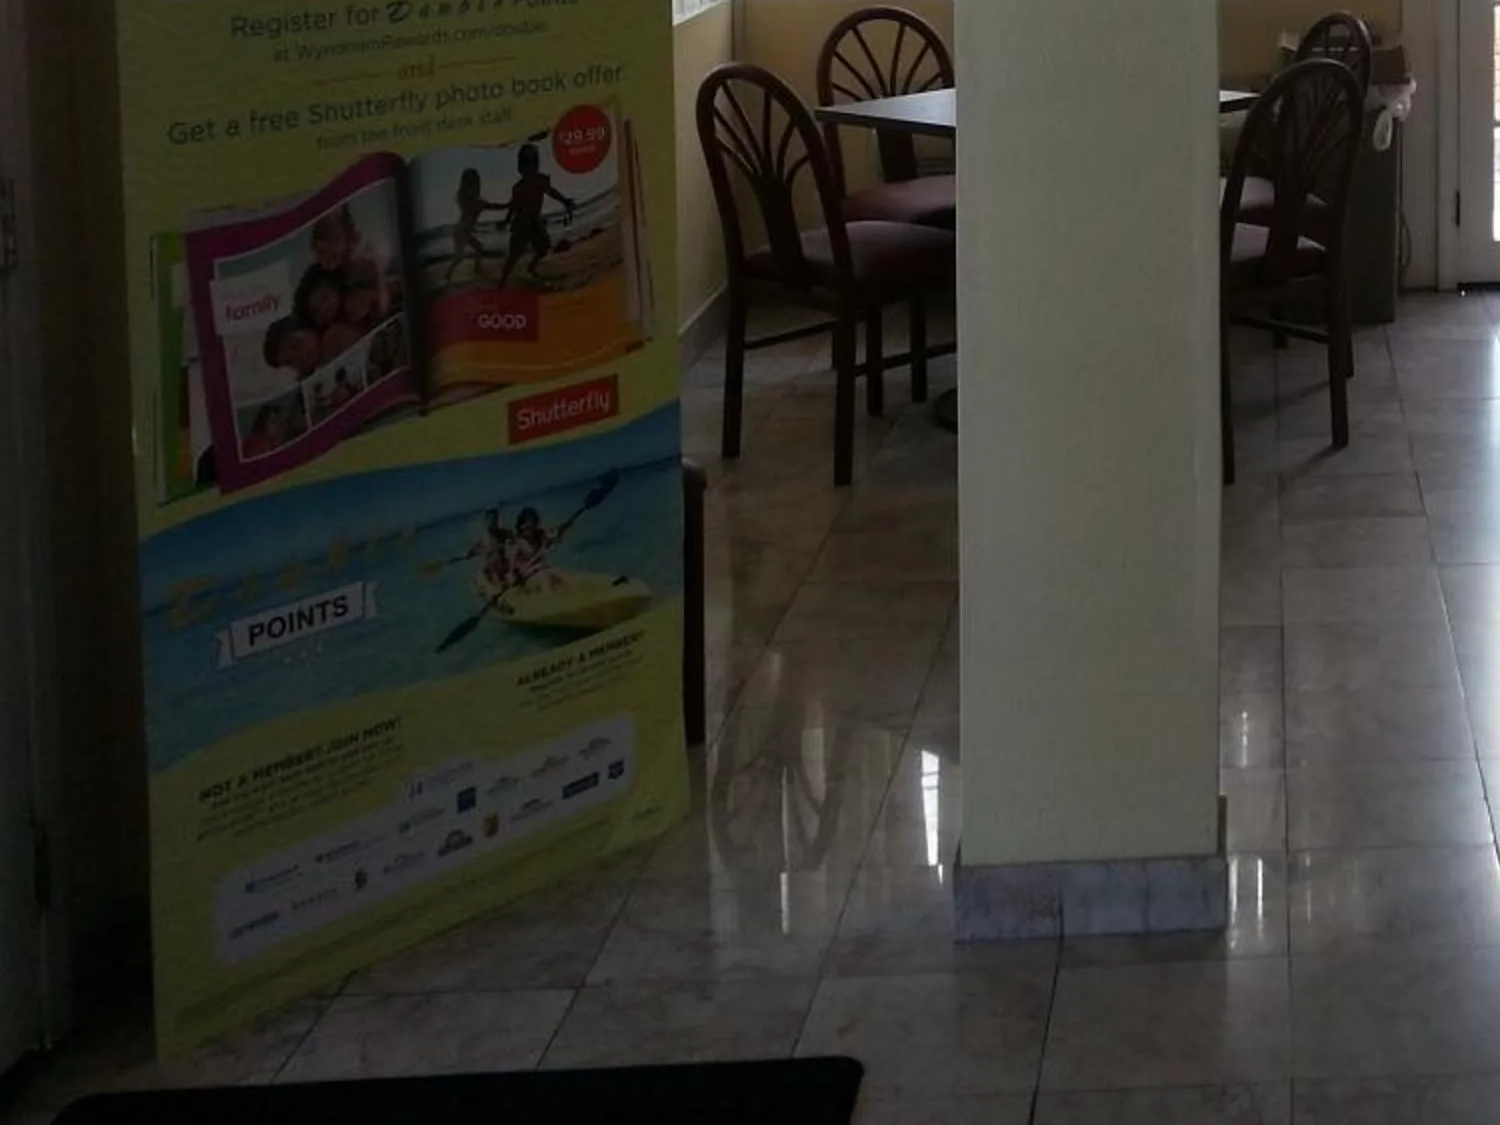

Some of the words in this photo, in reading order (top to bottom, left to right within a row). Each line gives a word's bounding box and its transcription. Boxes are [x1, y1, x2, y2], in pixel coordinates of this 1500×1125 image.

[231, 10, 337, 39] Register
[347, 4, 380, 26] for
[168, 119, 215, 145] Get
[224, 120, 240, 136] a
[250, 110, 300, 131] free
[308, 88, 427, 124] Shutterfly
[435, 81, 504, 110] photo
[512, 72, 567, 95] book
[574, 64, 623, 88] offer
[224, 287, 281, 324] family
[477, 311, 528, 331] GOOD
[515, 387, 612, 433] Shutterfly
[248, 594, 350, 648] POINTS
